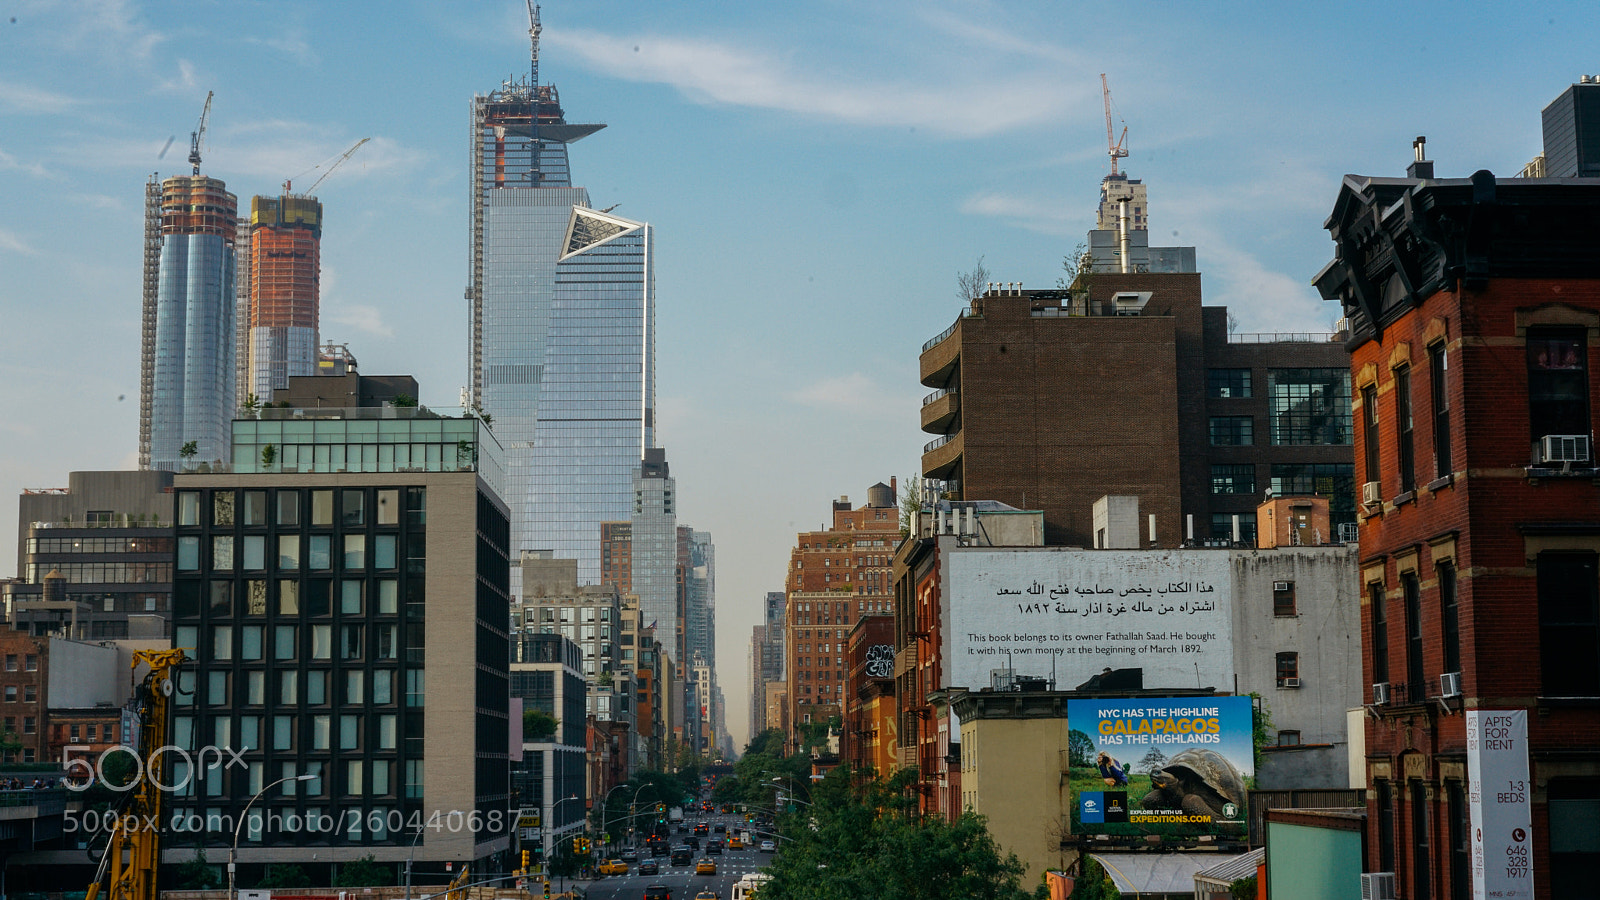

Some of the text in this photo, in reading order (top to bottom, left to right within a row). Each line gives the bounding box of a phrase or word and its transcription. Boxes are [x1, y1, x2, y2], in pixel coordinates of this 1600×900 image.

[996, 580, 1214, 600] هذا الكتاب يخص صاحبه فتح الله سعد
[1018, 600, 1214, 616] اشتراه من ماله غرة اذار سنة ١٨٩٢
[968, 634, 986, 642] This
[988, 633, 1012, 642] book
[1014, 633, 1047, 644] belongs
[1062, 633, 1072, 641] its
[1106, 632, 1144, 641] Fathallah
[1146, 632, 1168, 640] Saad.
[1170, 632, 1183, 640] He
[1186, 632, 1216, 642] bought
[968, 646, 974, 655] it
[976, 646, 996, 655] with
[998, 646, 1011, 655] his
[1035, 648, 1064, 656] money
[1078, 646, 1092, 654] the
[1095, 646, 1136, 656] beginning
[1138, 645, 1148, 654] of
[1150, 644, 1177, 654] March
[1180, 644, 1203, 653] 1892.
[1098, 708, 1219, 718] NYC HAS THE HIGHLINE
[1098, 717, 1220, 735] GALAPÁGOS
[1484, 716, 1512, 727] APTS
[1486, 728, 1508, 738] FOR
[1099, 734, 1220, 744] HAS THE HIGHLANDS
[1486, 740, 1514, 750] RENT
[1508, 780, 1524, 791] 1-3
[1498, 793, 1525, 804] BEDS
[1130, 815, 1211, 823] EXPEDITIONS.COM
[1506, 845, 1528, 856] 646
[1508, 856, 1528, 867] 328
[1506, 868, 1528, 878] 1917
